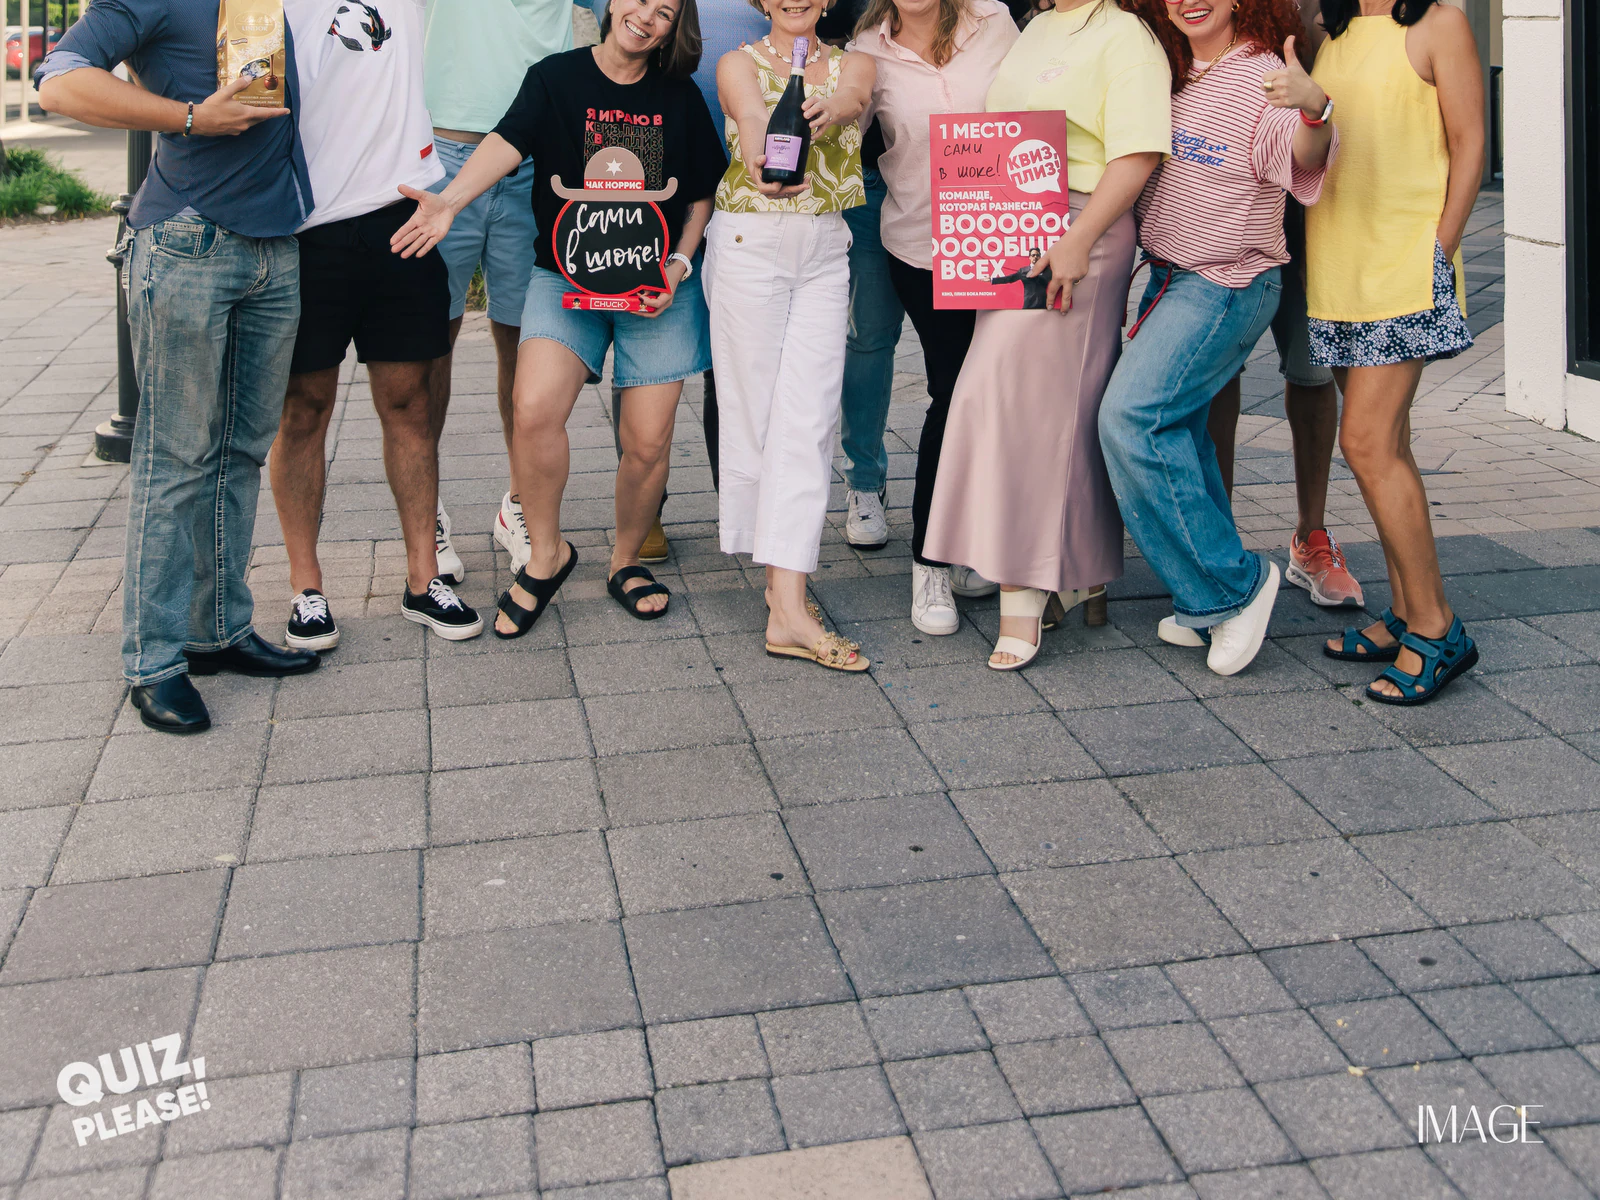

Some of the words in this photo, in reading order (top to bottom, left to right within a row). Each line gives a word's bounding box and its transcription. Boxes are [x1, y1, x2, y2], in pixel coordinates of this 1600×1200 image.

[586, 107, 597, 121] Я
[598, 109, 651, 126] ИГРАЮ
[653, 114, 663, 126] В
[939, 123, 948, 140] 1
[953, 121, 1022, 140] МЕСТО
[1008, 145, 1058, 171] КВИЗ,
[1010, 159, 1060, 186] ПЛИЗ!
[585, 180, 604, 189] ЧАК
[604, 181, 642, 190] НОРРИС
[939, 190, 993, 201] КОМАНДЕ,
[939, 202, 987, 212] КОТОРАЯ
[989, 201, 1043, 211] РАЗНЕСЛА
[576, 203, 643, 235] Сами
[565, 228, 581, 275] в
[585, 237, 661, 273] шоке!
[941, 258, 1006, 280] ВСЕХ
[593, 300, 624, 309] CHUCK
